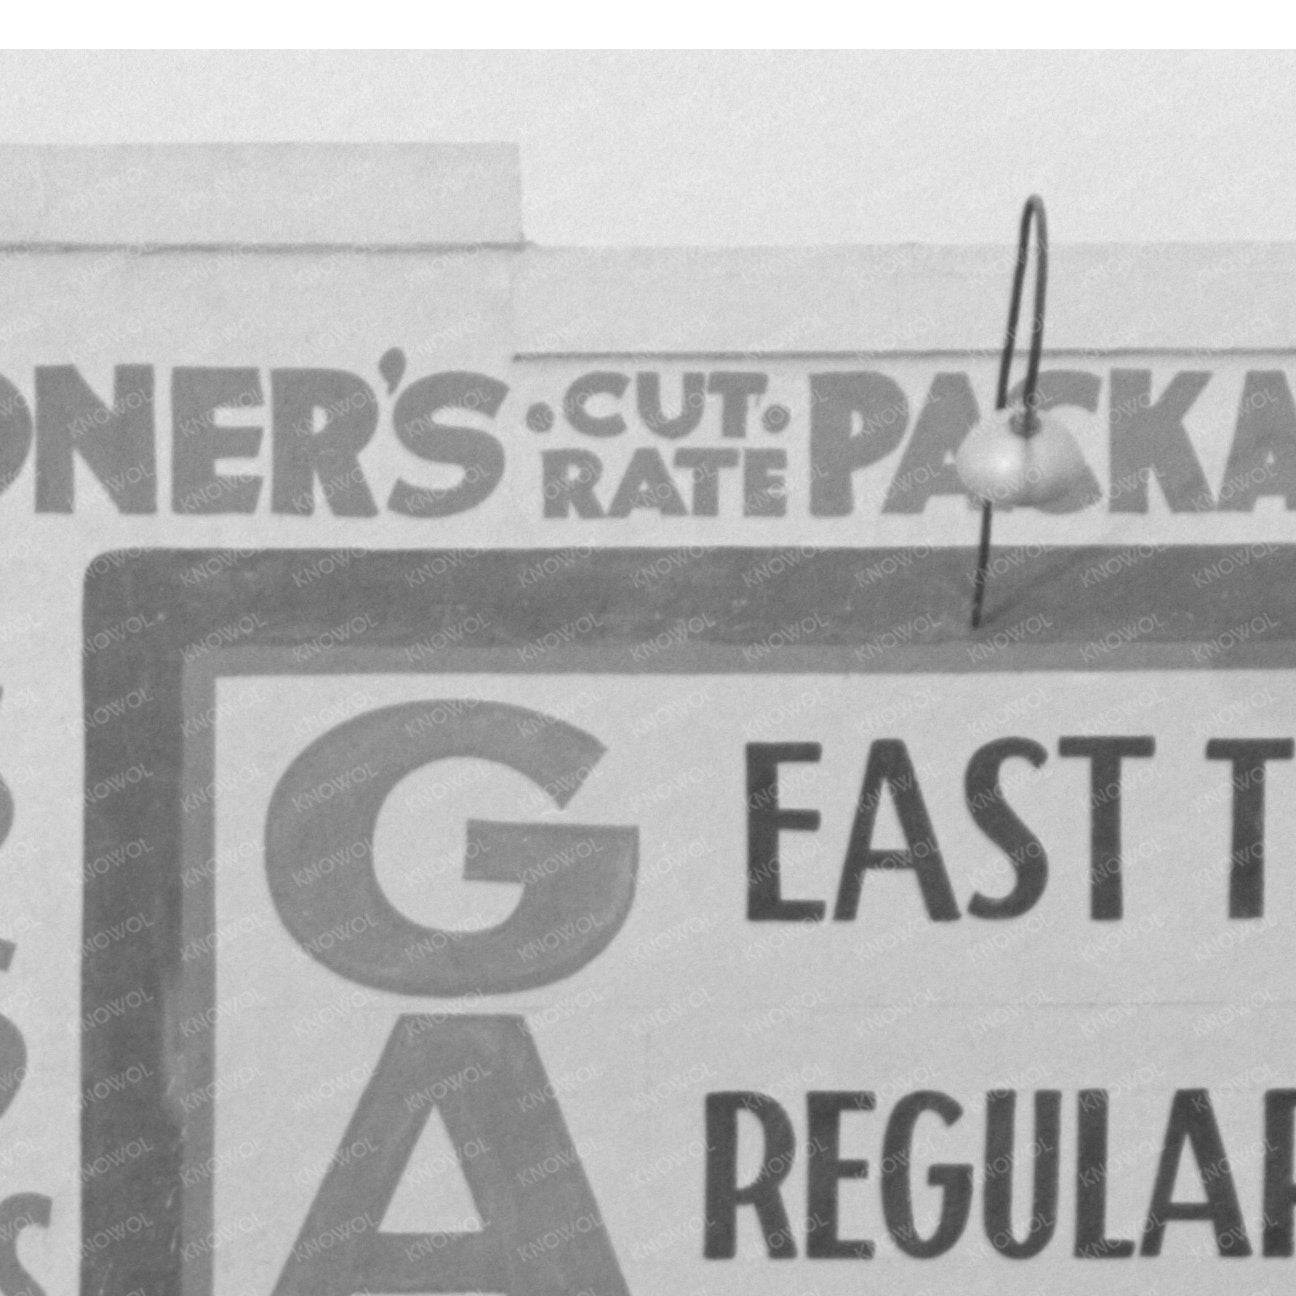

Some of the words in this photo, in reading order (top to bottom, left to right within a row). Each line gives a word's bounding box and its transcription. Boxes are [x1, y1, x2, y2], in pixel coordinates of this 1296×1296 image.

[563, 370, 769, 438] CUT
[542, 448, 787, 518] RATE
[744, 735, 1156, 922] EAST
